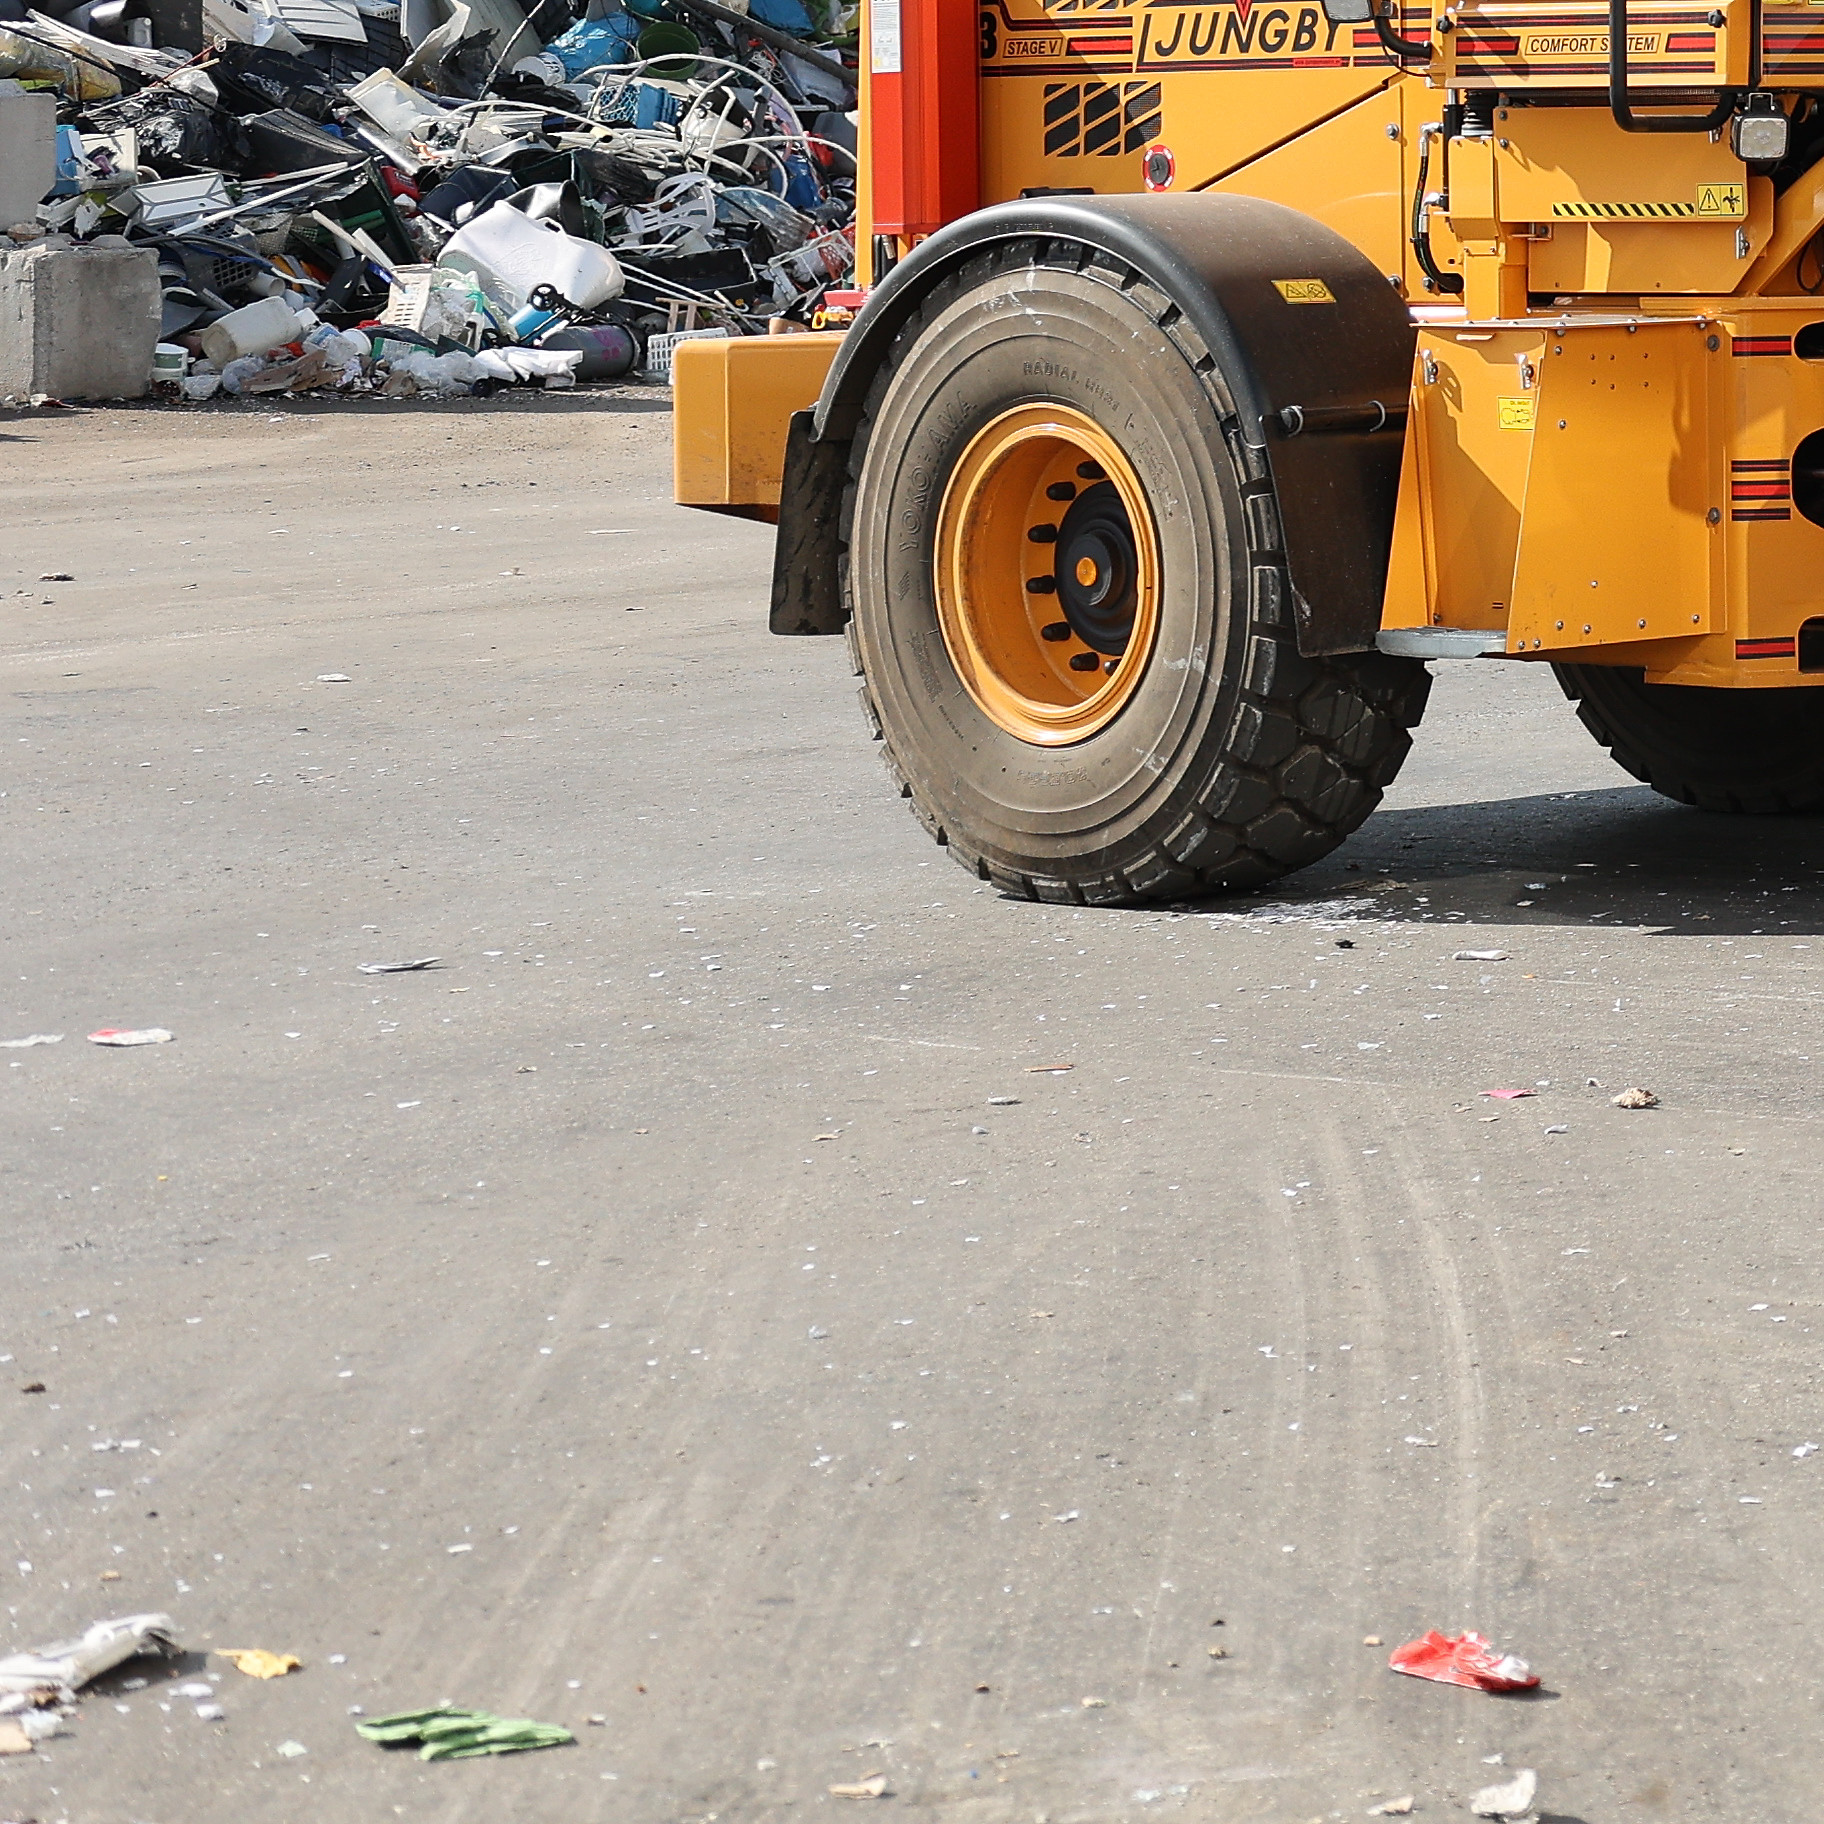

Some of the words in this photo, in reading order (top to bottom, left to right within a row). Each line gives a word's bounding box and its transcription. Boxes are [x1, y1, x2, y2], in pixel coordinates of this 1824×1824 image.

[1007, 40, 1046, 56] STAGE
[1048, 40, 1059, 54] V
[1530, 38, 1597, 53] COMFORT
[1600, 37, 1656, 52] STEM
